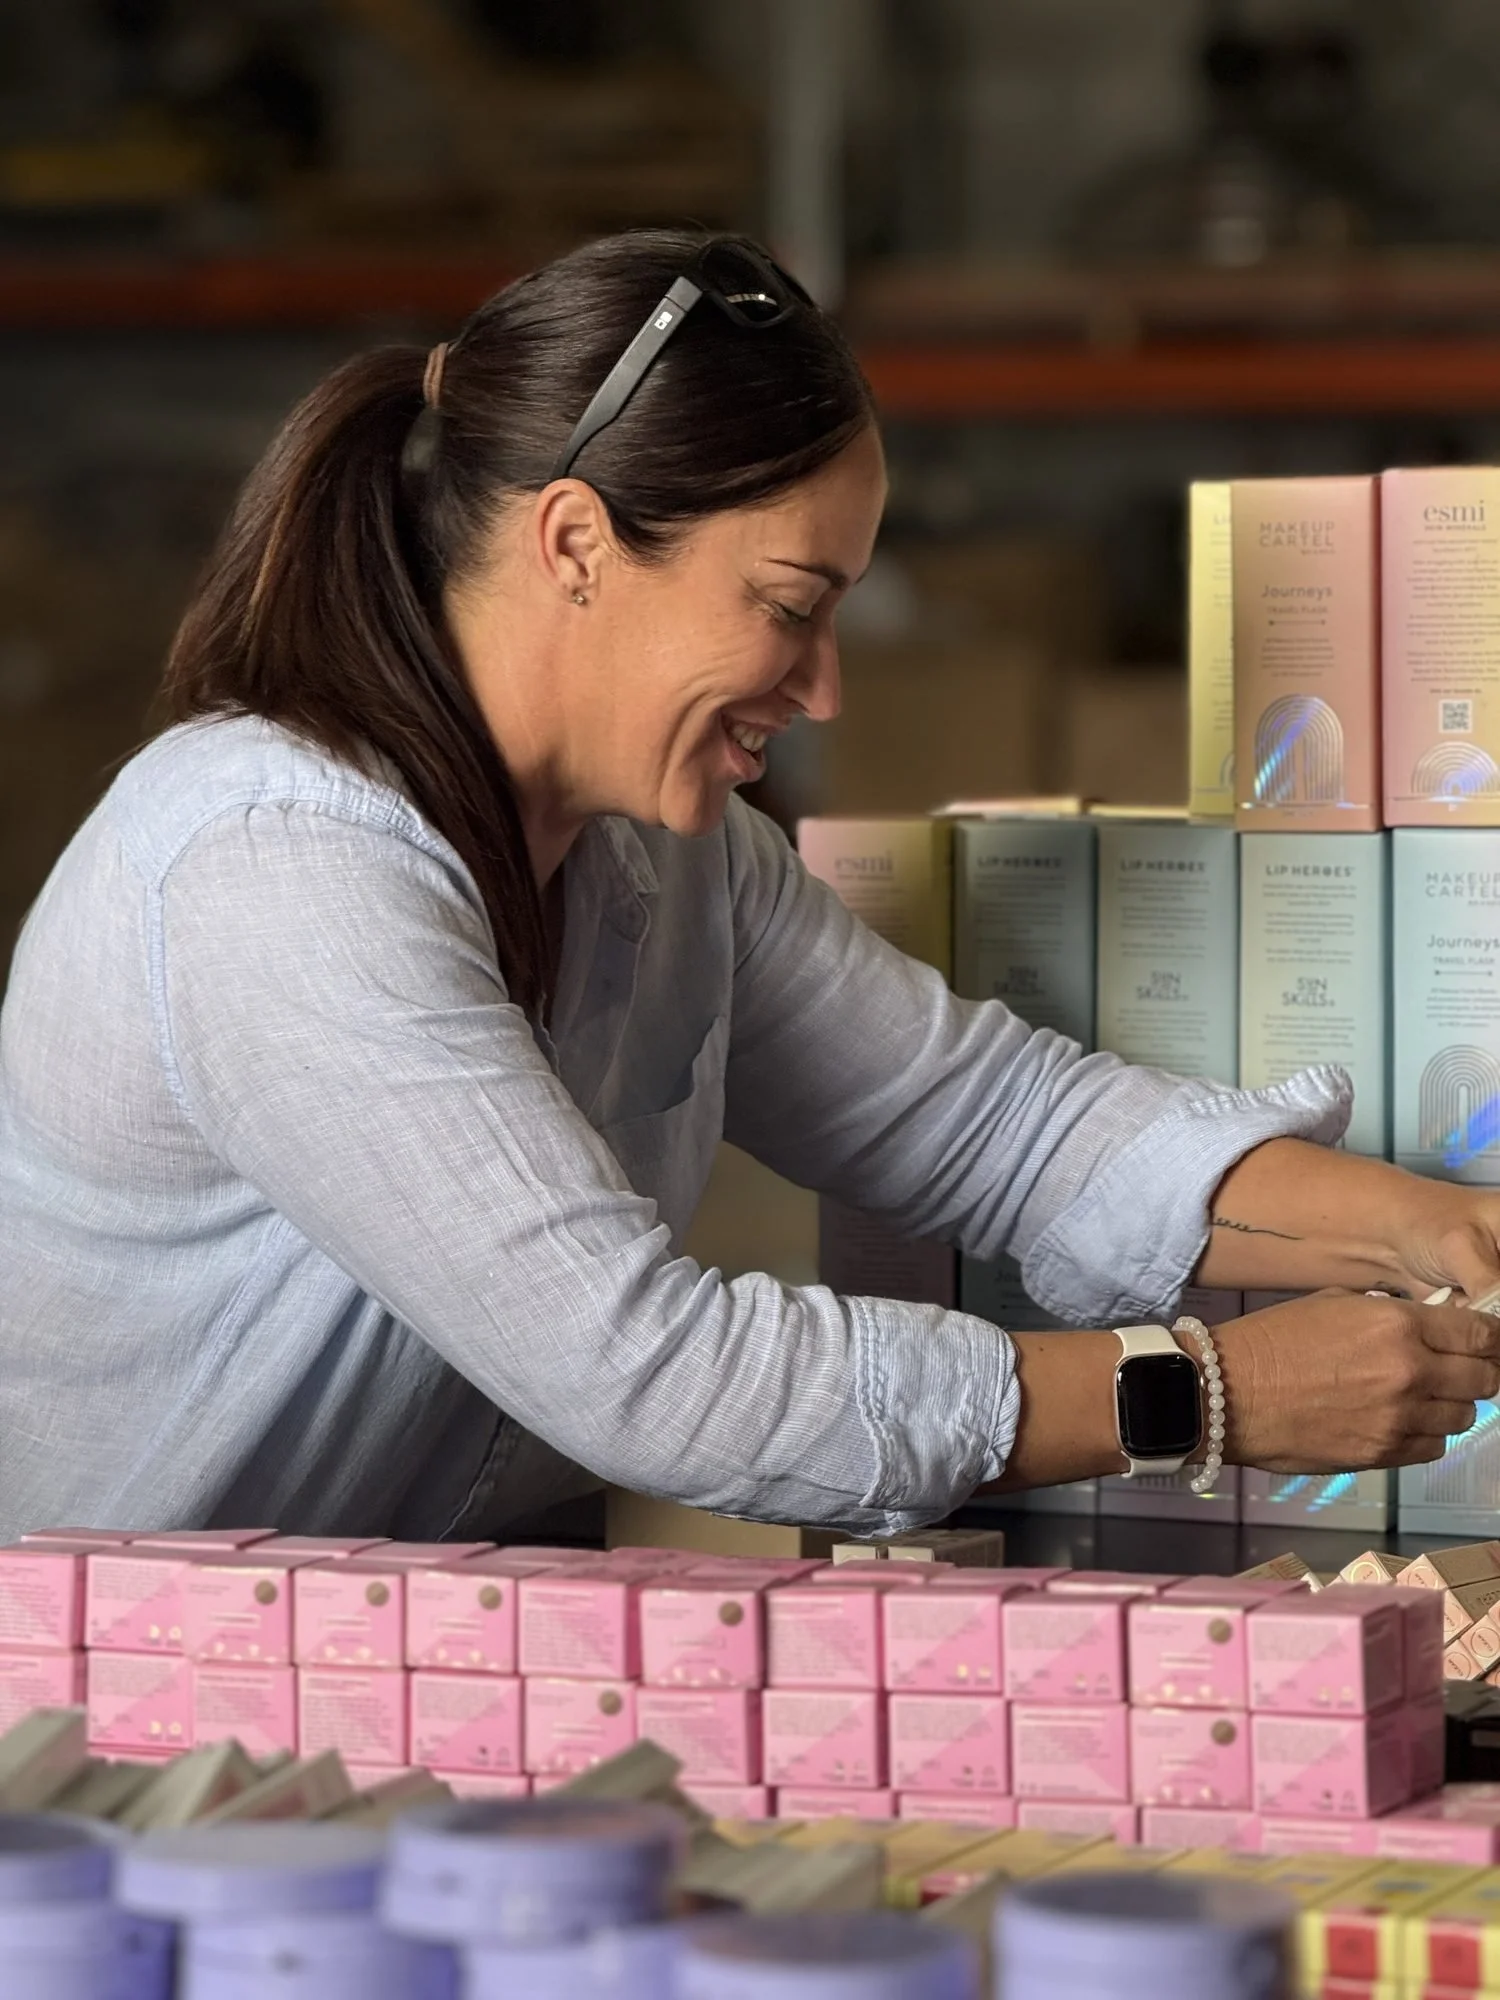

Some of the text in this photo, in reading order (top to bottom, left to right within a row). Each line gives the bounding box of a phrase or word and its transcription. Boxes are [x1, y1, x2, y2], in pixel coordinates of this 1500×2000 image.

[1423, 499, 1485, 521] esmi
[1260, 521, 1335, 533] MAKEUP
[1259, 534, 1334, 547] CARTEL
[1261, 584, 1333, 601] Journeys
[1265, 864, 1289, 877] LIP
[1426, 872, 1500, 884] MAKEUP
[1425, 885, 1500, 898] CARTEL
[1426, 934, 1500, 952] Journeys
